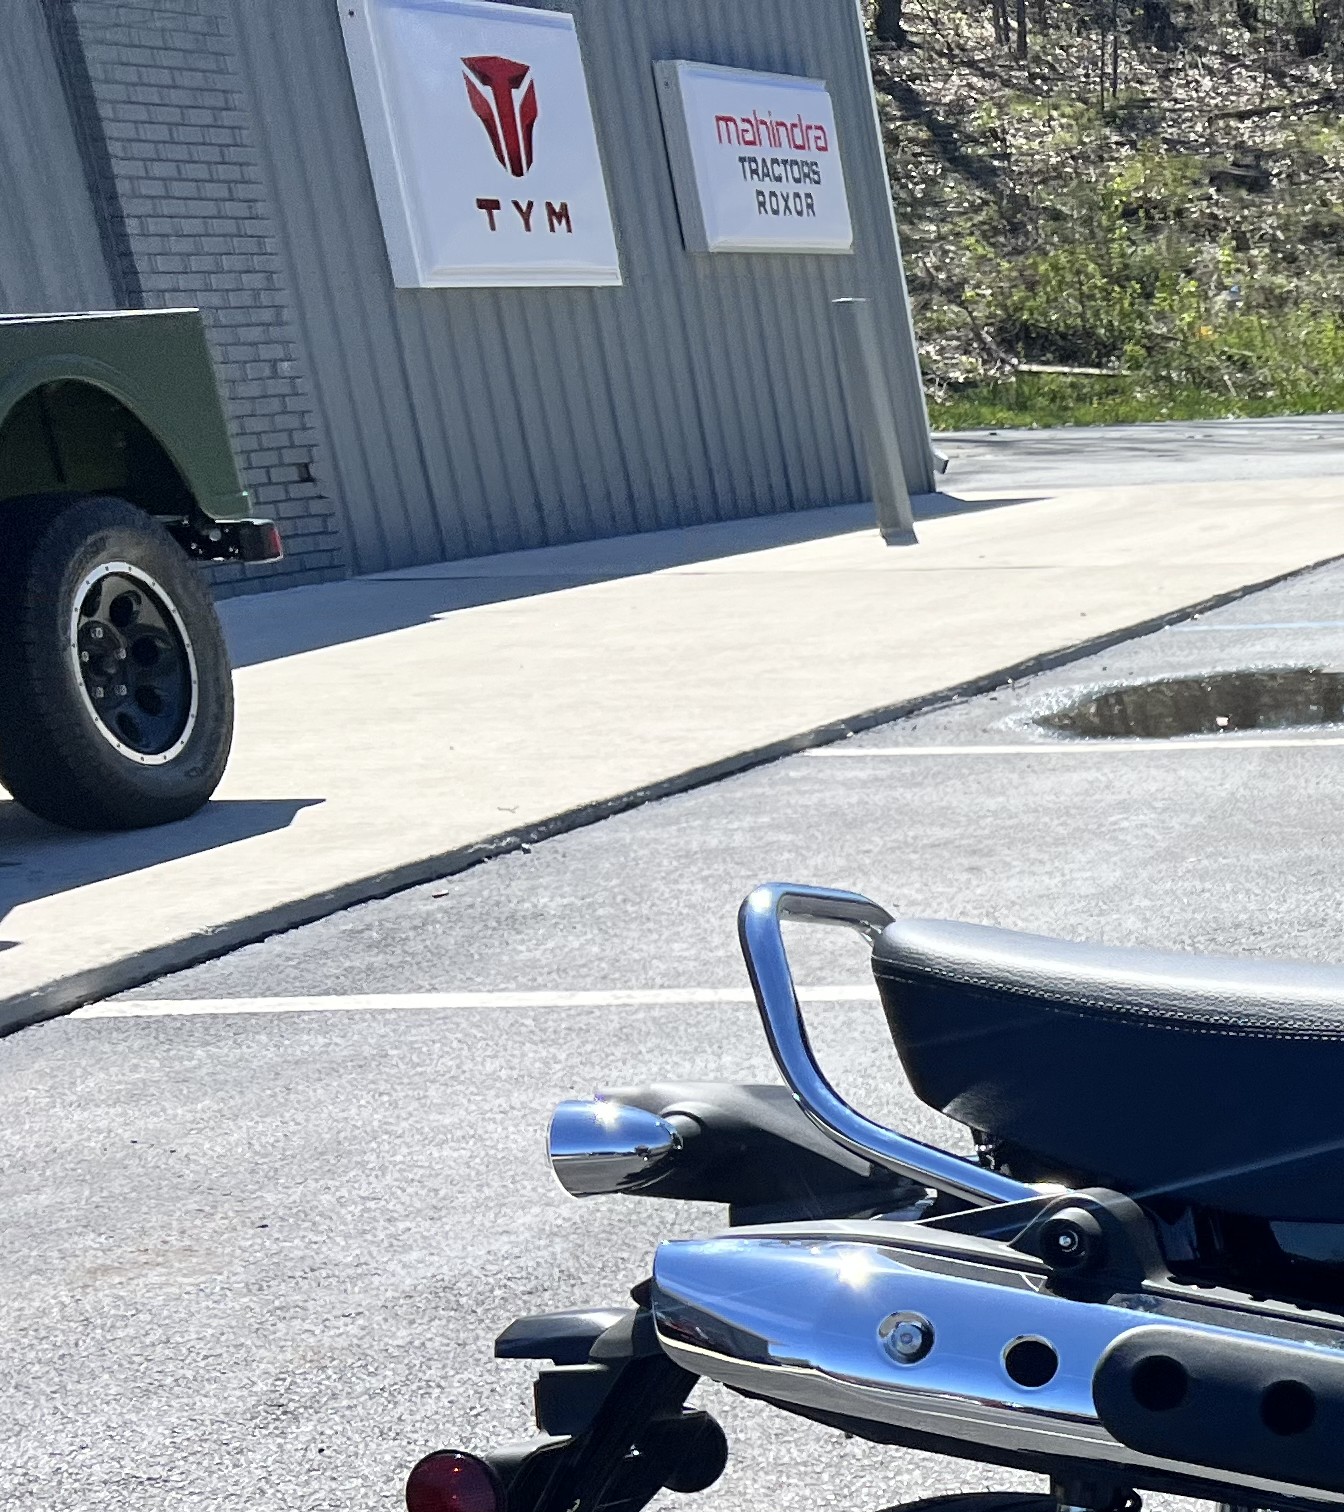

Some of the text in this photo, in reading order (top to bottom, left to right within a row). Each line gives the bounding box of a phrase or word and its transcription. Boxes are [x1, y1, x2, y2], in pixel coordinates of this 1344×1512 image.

[714, 110, 829, 153] mahindra
[738, 155, 822, 186] TRACTORS
[475, 198, 573, 234] TYM
[755, 189, 817, 218] ROXOR
